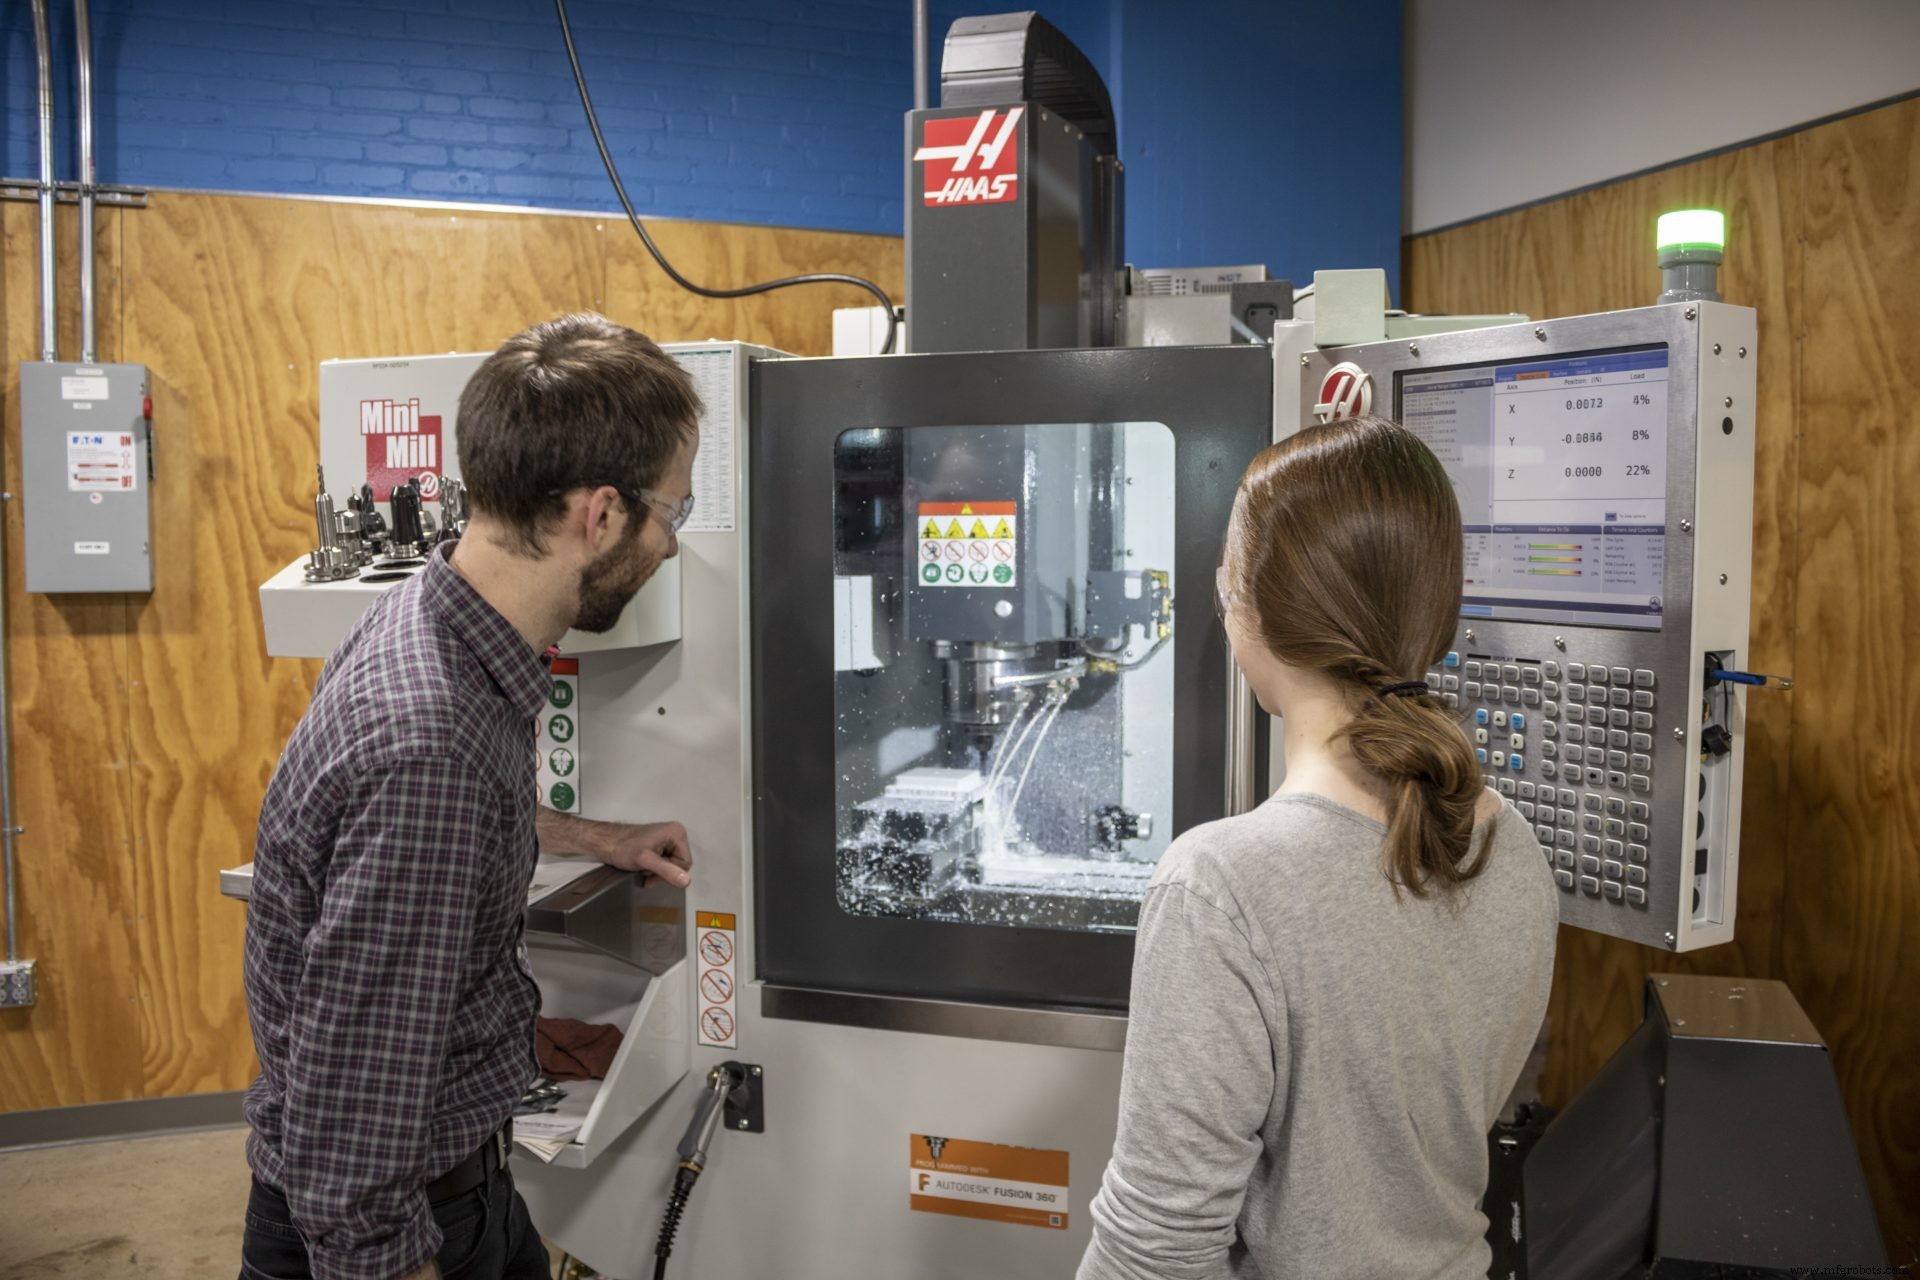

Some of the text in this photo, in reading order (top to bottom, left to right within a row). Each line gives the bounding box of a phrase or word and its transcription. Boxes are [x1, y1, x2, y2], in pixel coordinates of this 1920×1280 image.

[924, 173, 1018, 203] HAAS
[1630, 372, 1646, 380] Load
[361, 399, 419, 434] Mini
[1509, 404, 1516, 414] X
[1508, 436, 1515, 446] Y
[1632, 429, 1650, 441] 8%
[386, 434, 436, 469] Mill
[1507, 464, 1651, 479] Z 0.0000 22%
[935, 1180, 990, 1195] AUTODESK
[994, 1187, 1033, 1200] FUSION
[1035, 1192, 1057, 1203] 360
